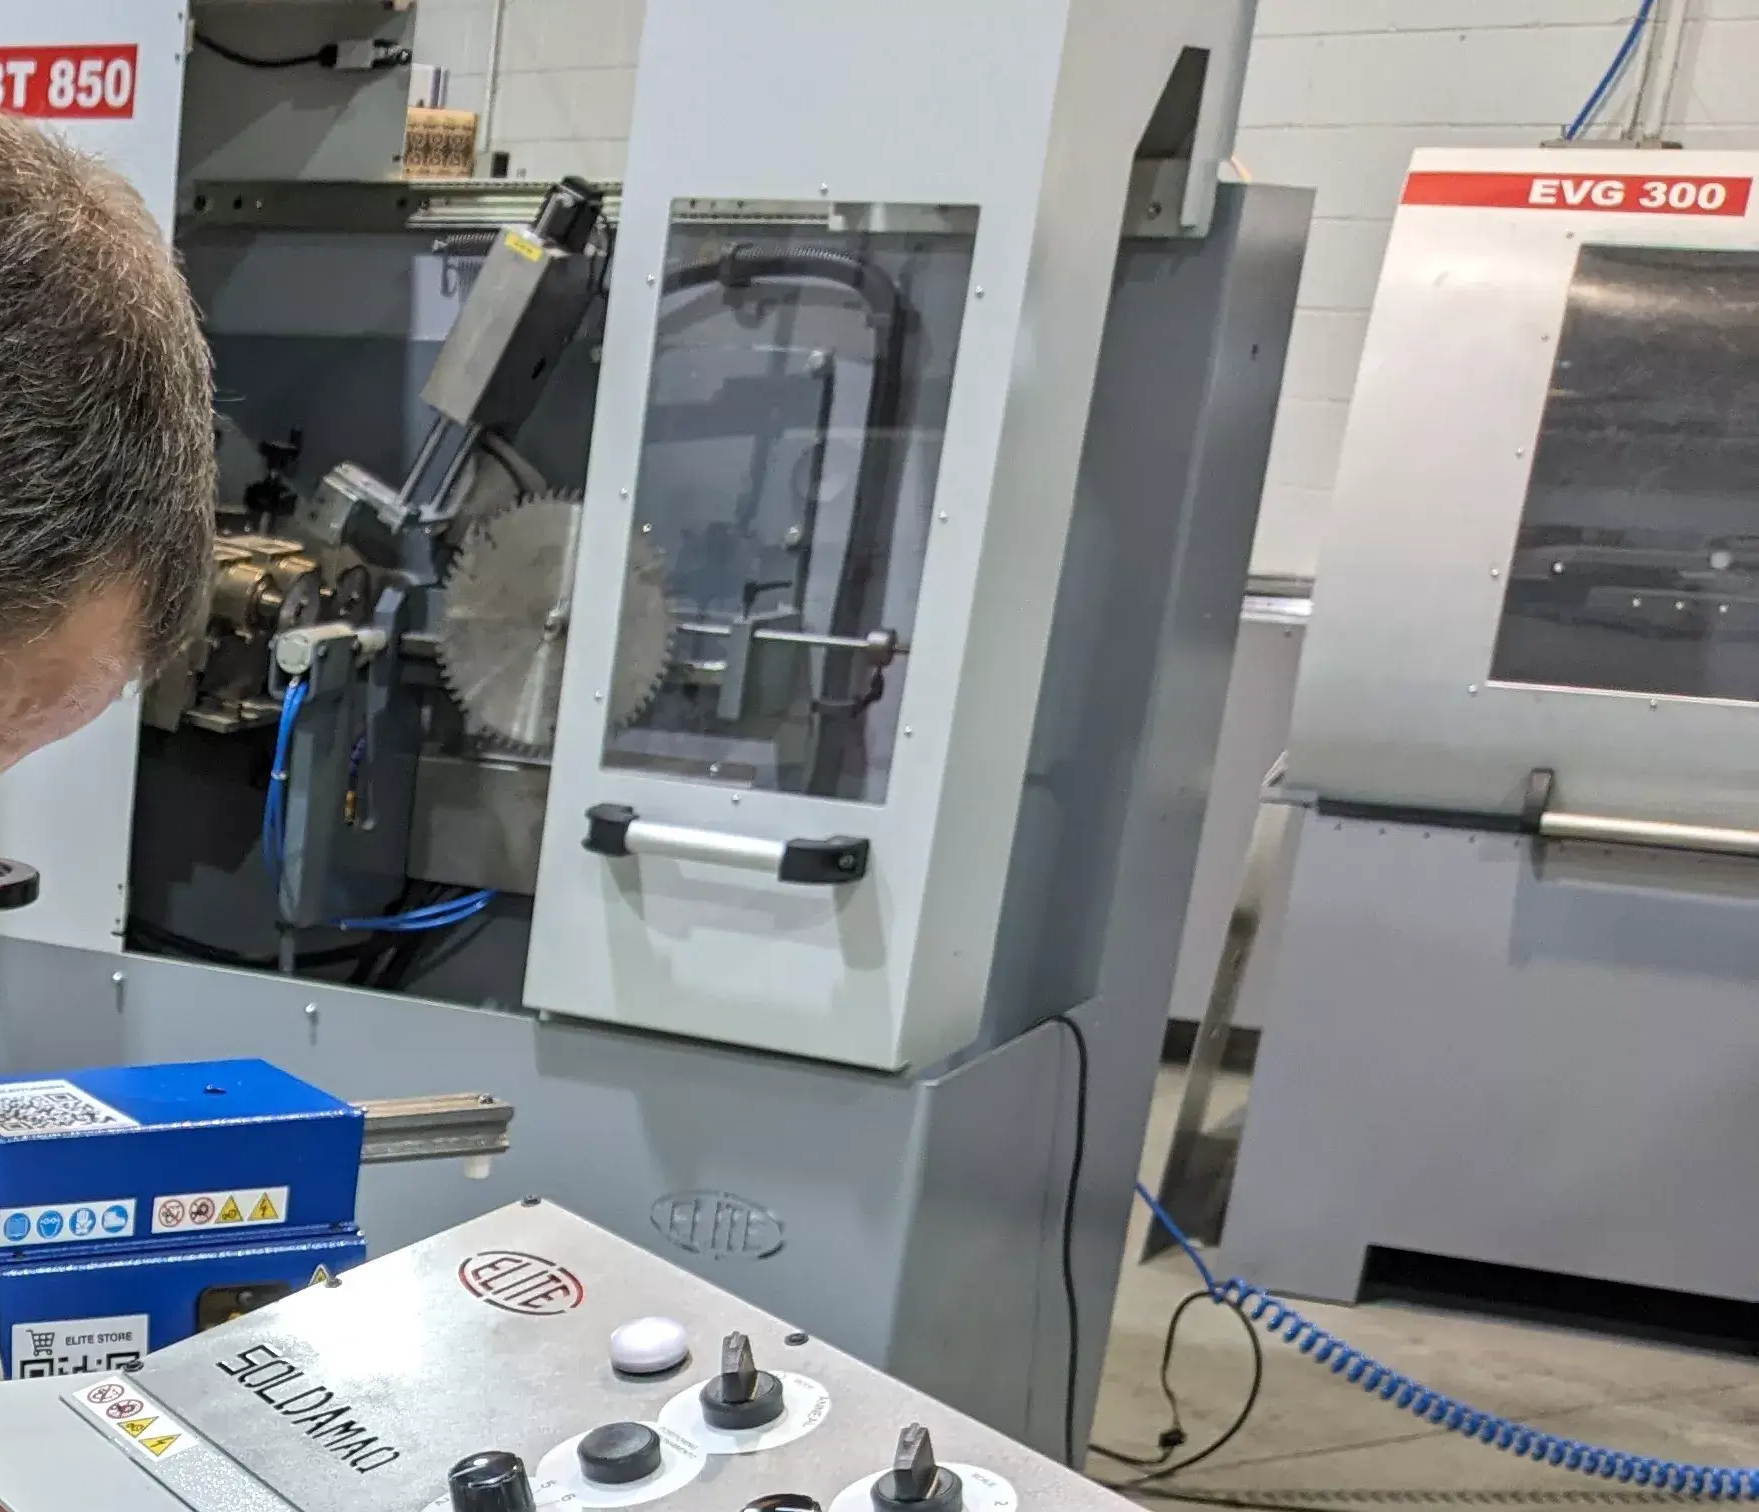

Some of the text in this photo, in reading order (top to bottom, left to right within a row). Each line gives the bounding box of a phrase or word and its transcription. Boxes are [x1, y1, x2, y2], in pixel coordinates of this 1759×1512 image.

[47, 57, 132, 109] 850
[1528, 178, 1727, 210] EVG 300
[668, 1199, 764, 1254] ELITE
[471, 1256, 571, 1310] ELITE
[64, 1331, 133, 1347] ELITE STORE
[215, 1343, 401, 1475] SOLDAMAQ
